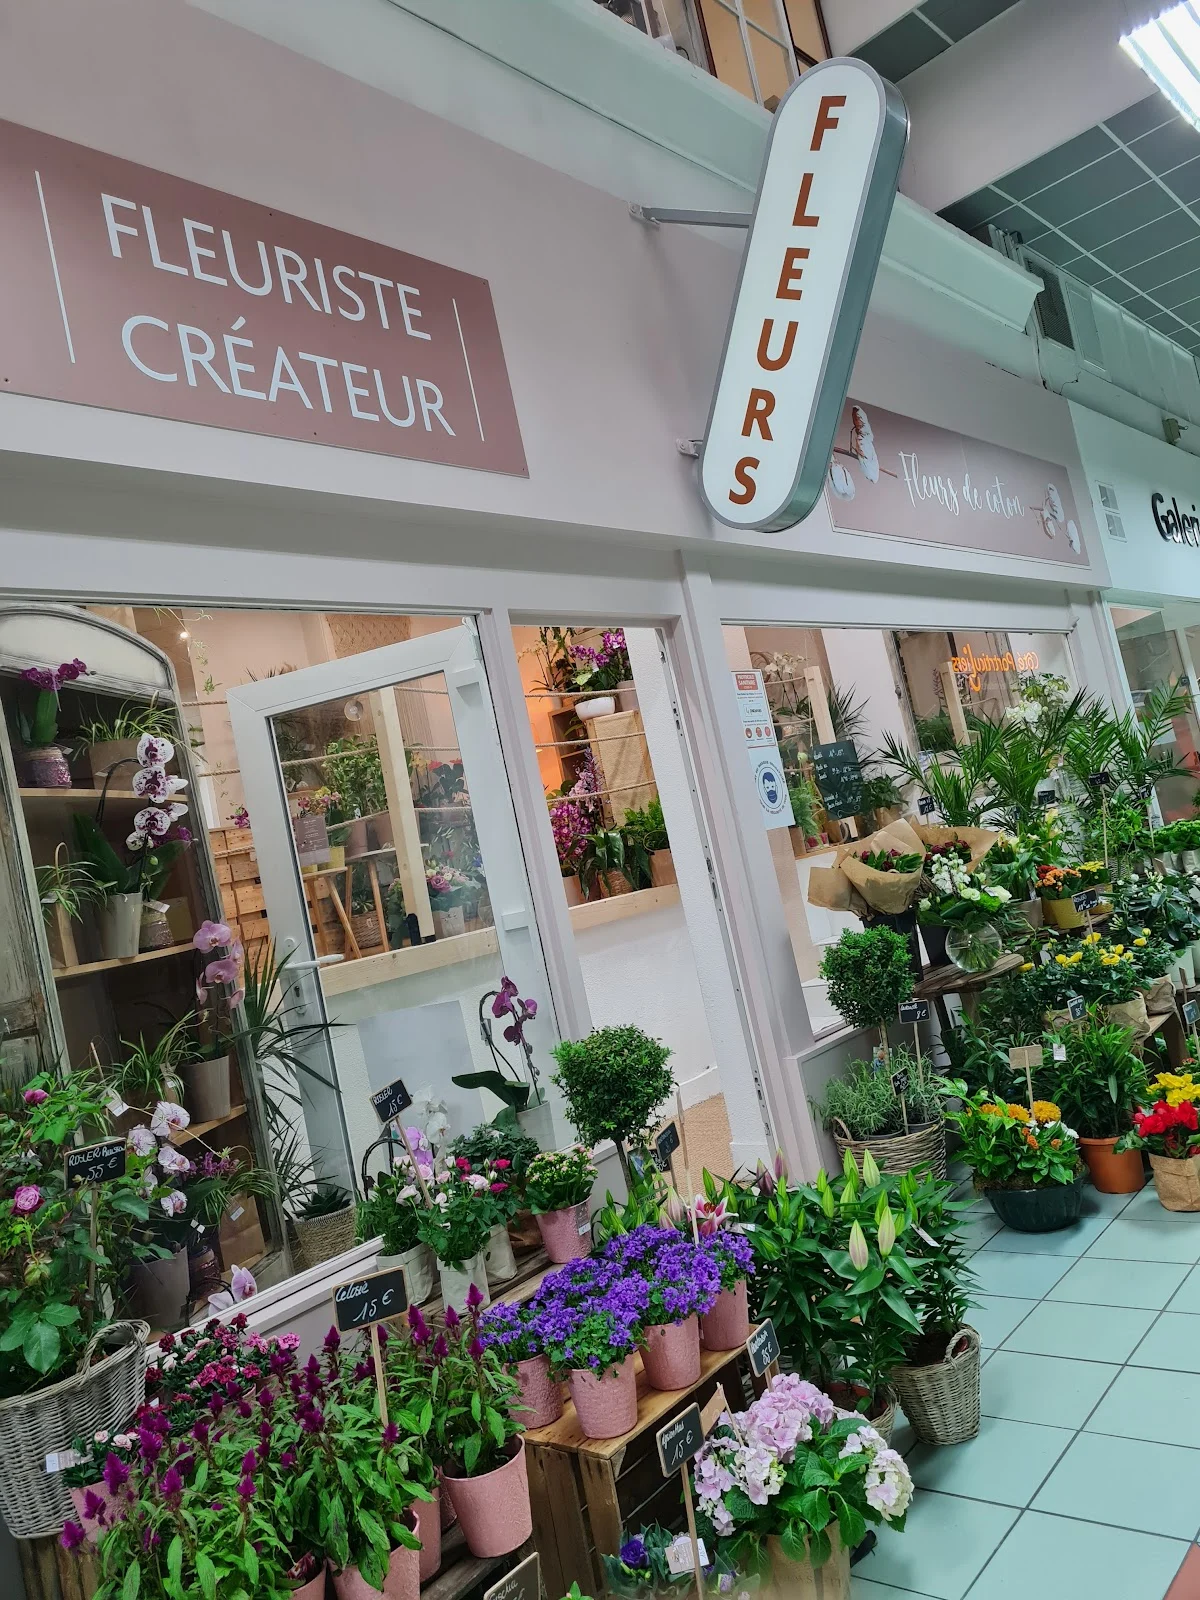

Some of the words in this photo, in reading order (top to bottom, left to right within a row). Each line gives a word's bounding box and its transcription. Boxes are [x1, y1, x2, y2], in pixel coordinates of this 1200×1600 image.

[101, 193, 431, 341] FLEURISTE
[728, 95, 847, 506] FLEURS
[121, 316, 456, 437] CRÉATEUR
[898, 450, 959, 516] Fleurs
[962, 473, 983, 511] de
[985, 475, 1025, 519] coton
